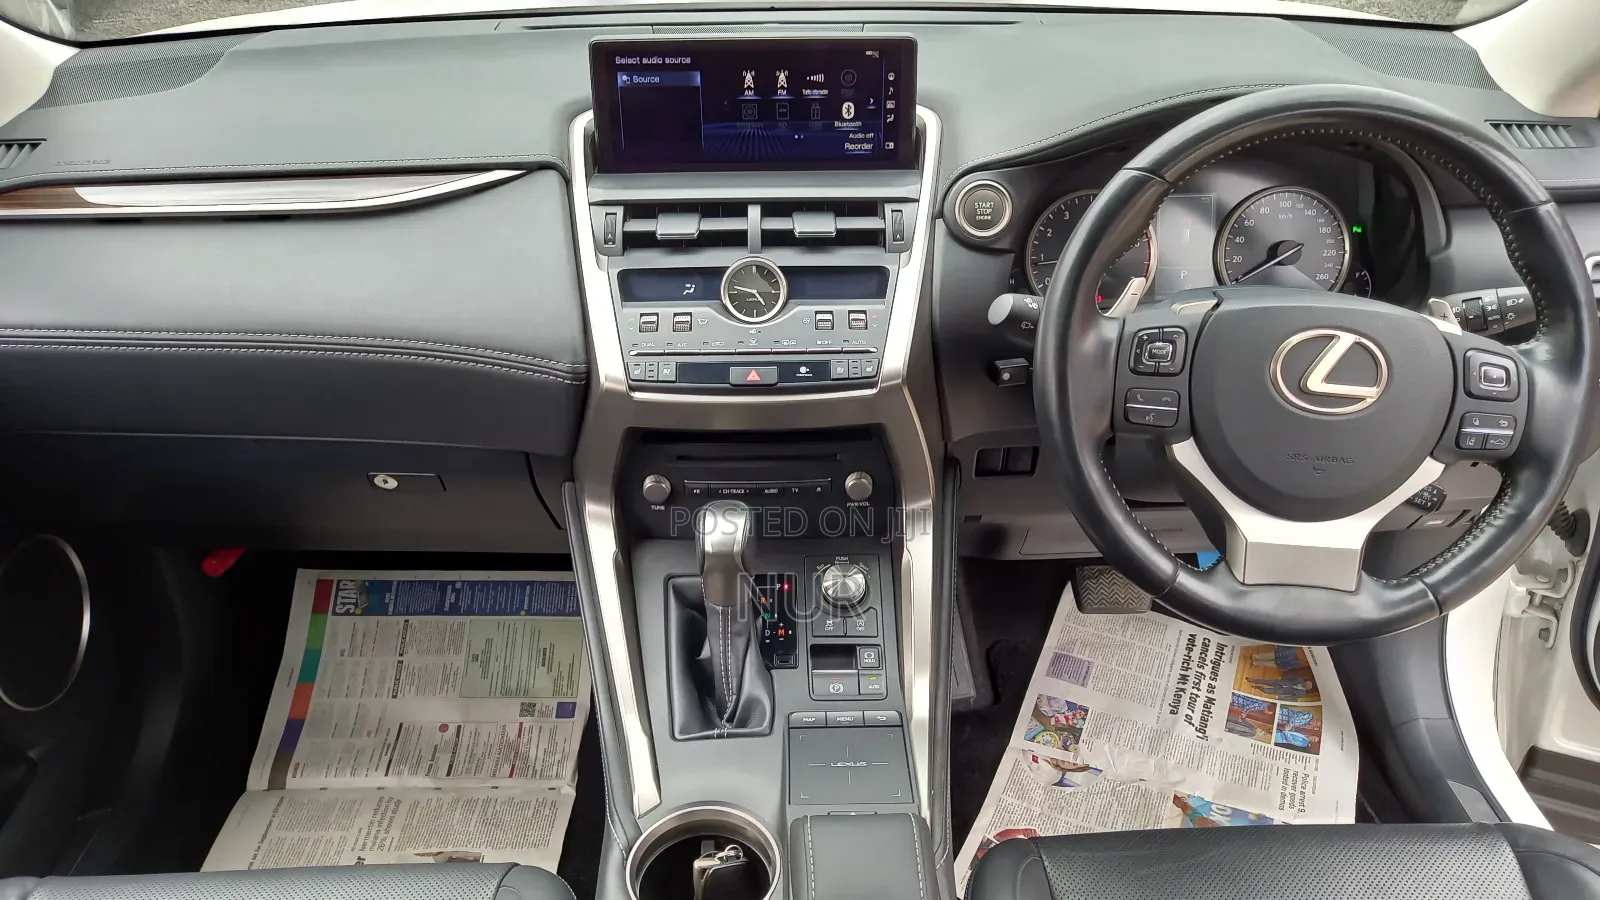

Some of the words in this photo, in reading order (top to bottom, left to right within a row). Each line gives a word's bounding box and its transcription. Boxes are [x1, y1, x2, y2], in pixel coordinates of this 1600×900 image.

[615, 56, 641, 65] Select
[642, 56, 663, 65] audio
[632, 75, 660, 84] Source
[1279, 200, 1292, 208] 100
[1063, 211, 1070, 220] 3
[1259, 206, 1270, 215] 80
[1304, 208, 1317, 216] 140
[1244, 219, 1255, 227] 60
[1046, 228, 1053, 237] 2
[1318, 226, 1332, 234] 180
[1234, 236, 1245, 244] 40
[1040, 253, 1045, 261] 1
[1322, 249, 1337, 257] 220
[1232, 255, 1243, 263] 20
[1180, 270, 1188, 280] P
[1315, 273, 1329, 281] 260
[1286, 453, 1308, 462] SRS
[1413, 496, 1427, 506] SET
[816, 563, 826, 571] Eco
[775, 583, 781, 591] P
[335, 580, 357, 614] STAR
[1179, 633, 1198, 672] vote-rich
[1197, 637, 1212, 670] cancels
[1209, 642, 1228, 682] Intrigues
[1176, 673, 1190, 685] Mt
[1192, 670, 1206, 692] first
[1207, 683, 1217, 694] as
[1168, 685, 1187, 715] Kenya
[1186, 692, 1201, 714] tour
[1184, 714, 1195, 728] of
[1194, 695, 1217, 741] Matiang'i
[1281, 767, 1290, 785] looted
[1290, 771, 1299, 792] recover
[1300, 773, 1310, 790] Police
[1278, 791, 1288, 811] demos
[1288, 792, 1297, 809] goods
[1298, 790, 1306, 808] arrest
[357, 819, 375, 852] Ivermectin
[370, 796, 385, 818] reduces
[368, 829, 382, 852] malaria
[376, 803, 391, 829] infection
[384, 796, 394, 804] by
[376, 835, 390, 852] 26%,
[383, 815, 396, 835] shows
[390, 799, 403, 815] study
